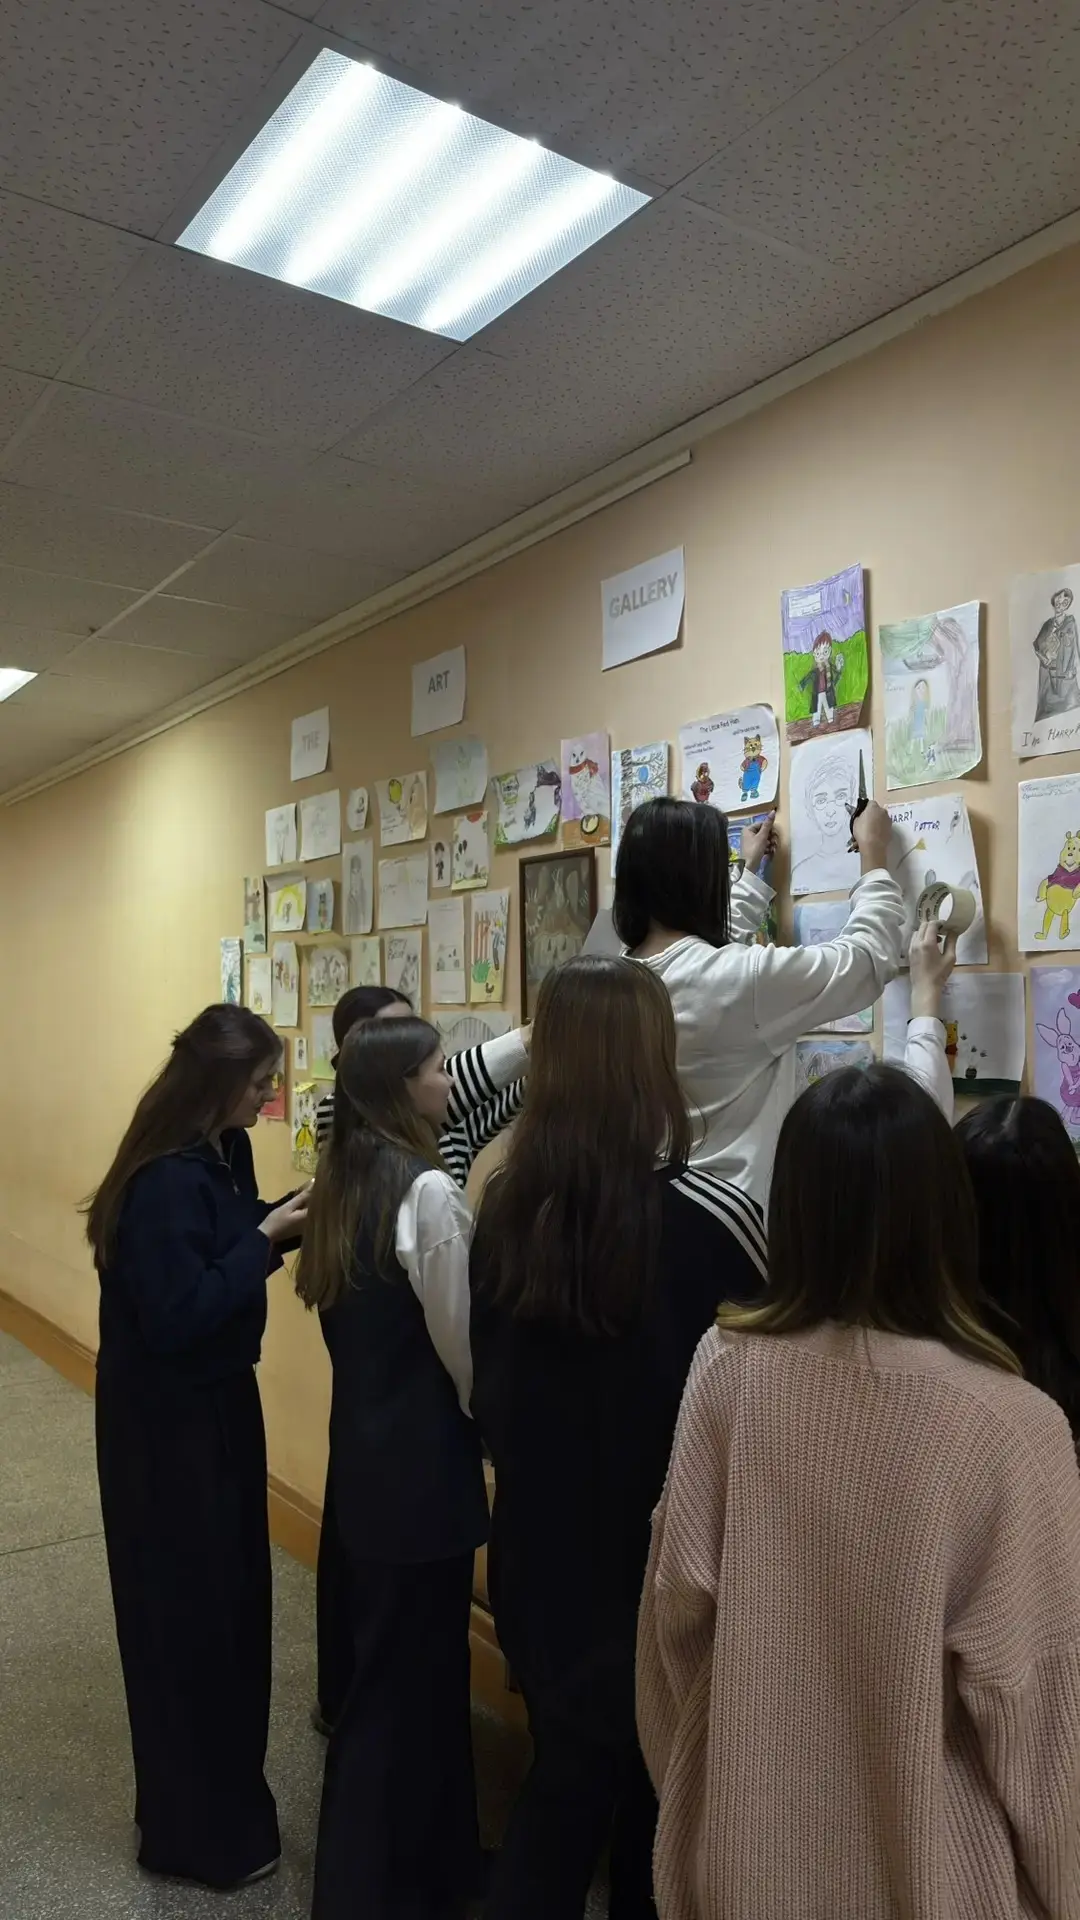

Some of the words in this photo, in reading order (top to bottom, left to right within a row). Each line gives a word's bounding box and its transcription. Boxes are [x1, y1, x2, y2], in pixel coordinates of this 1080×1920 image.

[608, 571, 678, 619] GALLERY
[427, 669, 451, 695] ART
[301, 730, 320, 751] THE
